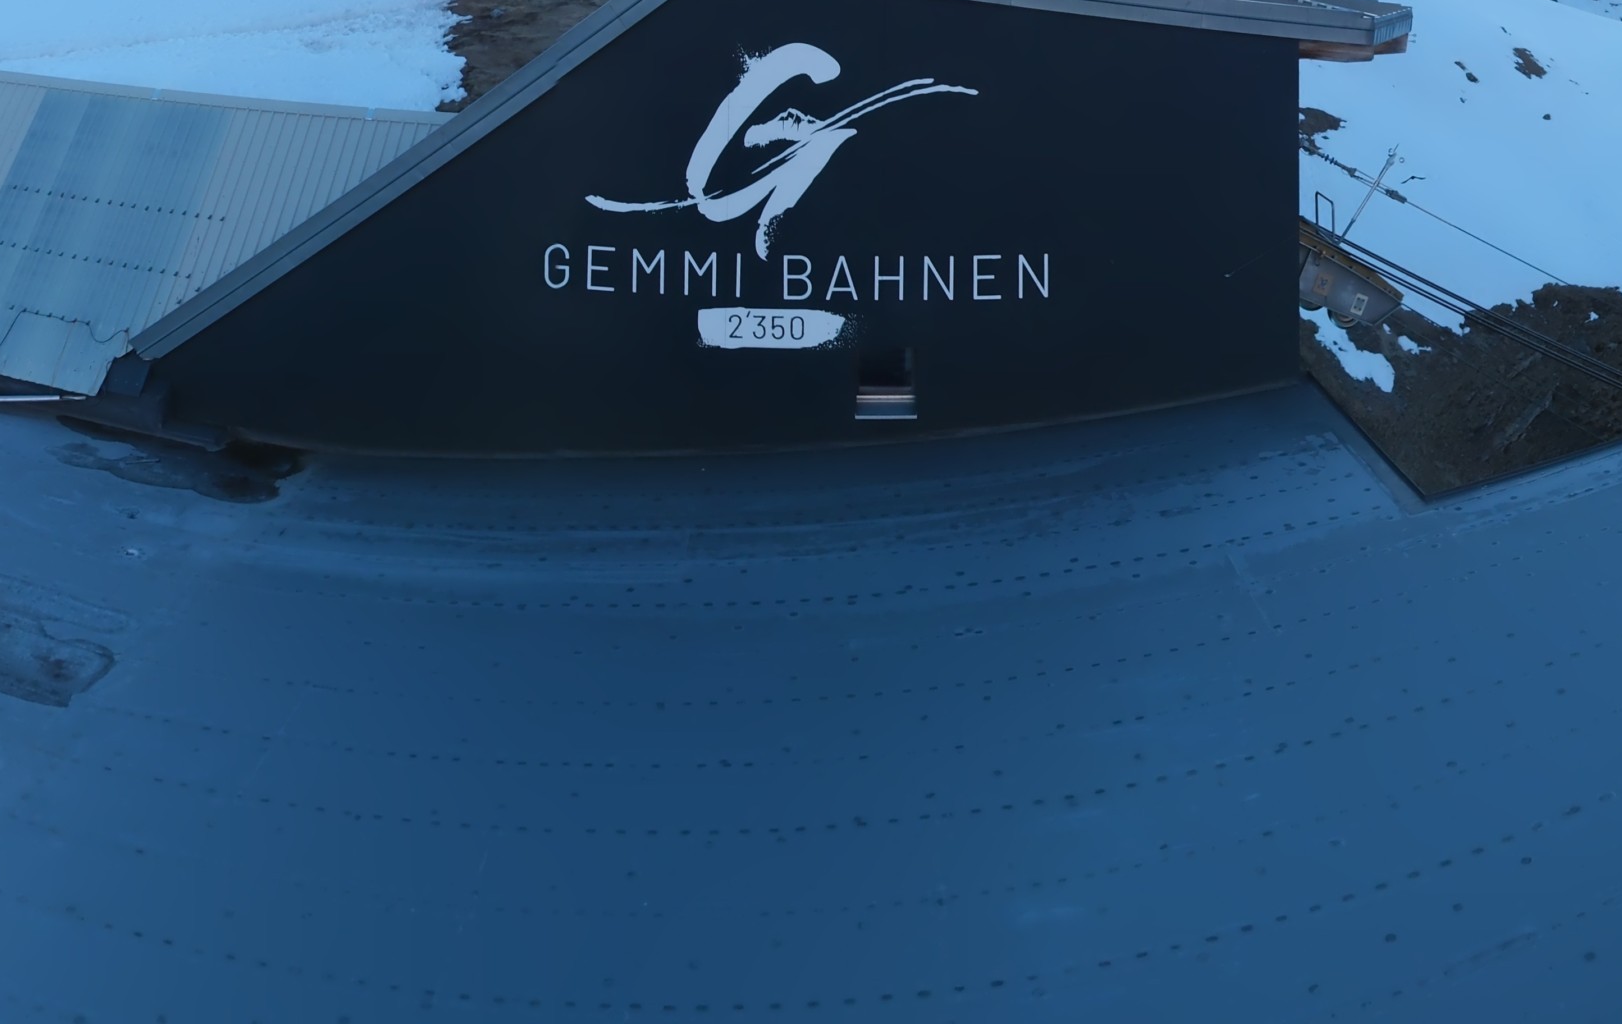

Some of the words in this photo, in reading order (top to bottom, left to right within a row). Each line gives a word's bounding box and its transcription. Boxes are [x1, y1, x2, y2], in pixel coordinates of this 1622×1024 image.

[544, 243, 742, 298] GEMMI
[782, 253, 1050, 301] BAHNEN
[727, 309, 806, 341] 2'350
